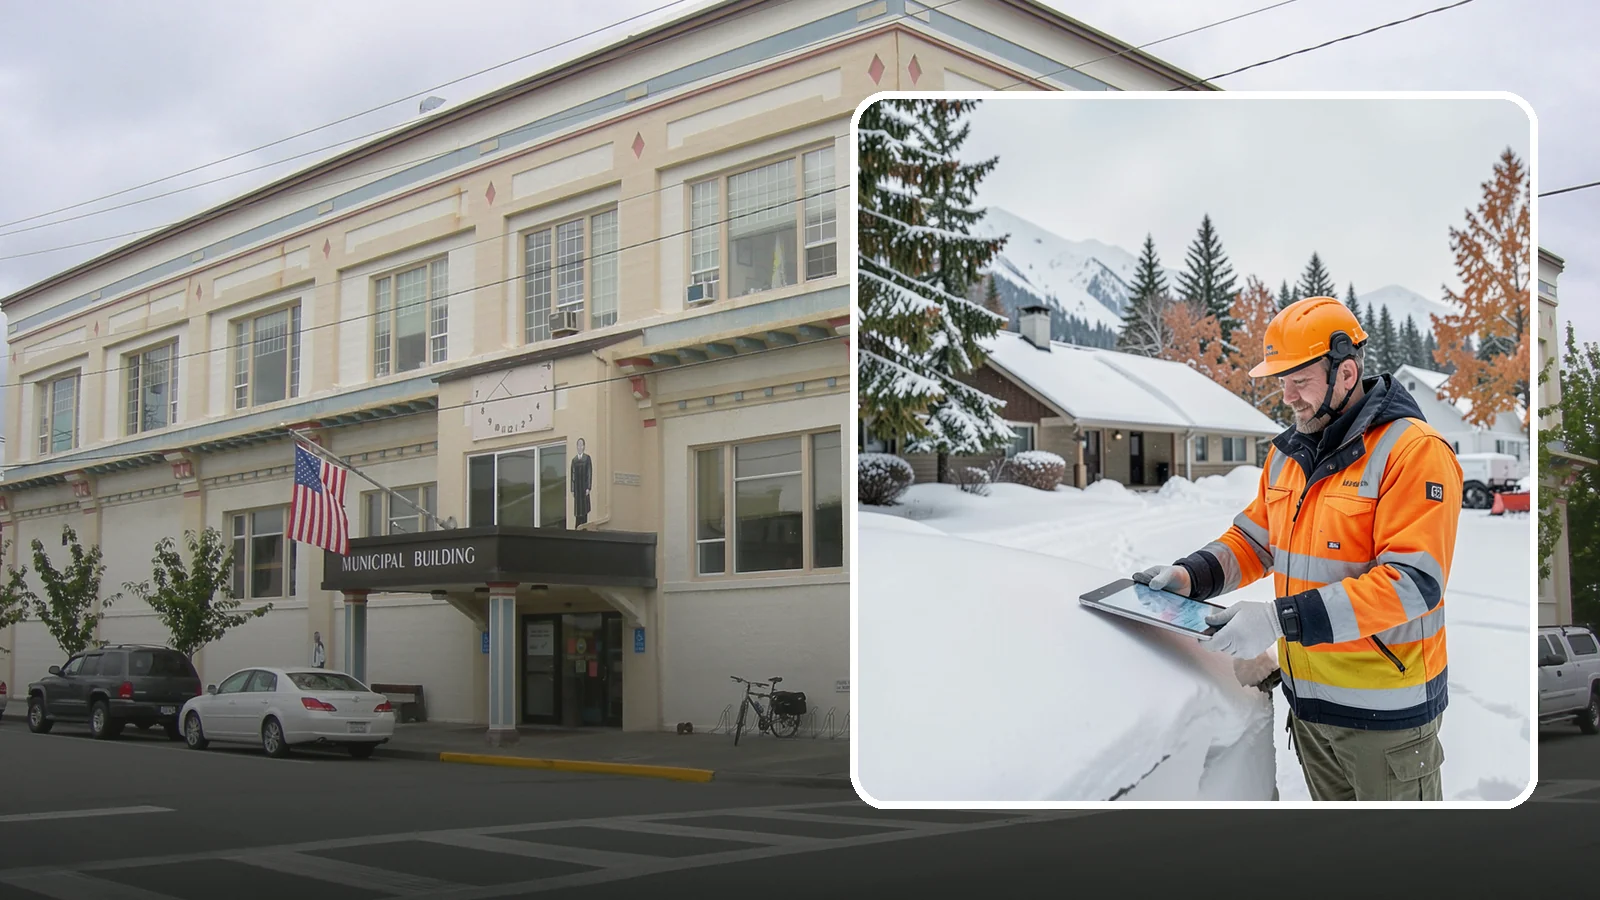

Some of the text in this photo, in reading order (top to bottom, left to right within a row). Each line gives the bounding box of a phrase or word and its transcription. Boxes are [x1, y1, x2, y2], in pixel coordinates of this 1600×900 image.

[480, 407, 485, 415] 8
[487, 417, 492, 426] 9
[494, 423, 500, 432] 10
[507, 425, 514, 433] 12
[521, 420, 526, 428] 2
[528, 414, 533, 422] 3
[536, 402, 540, 410] 4
[342, 546, 475, 572] MUNICIPAL BUILDING
